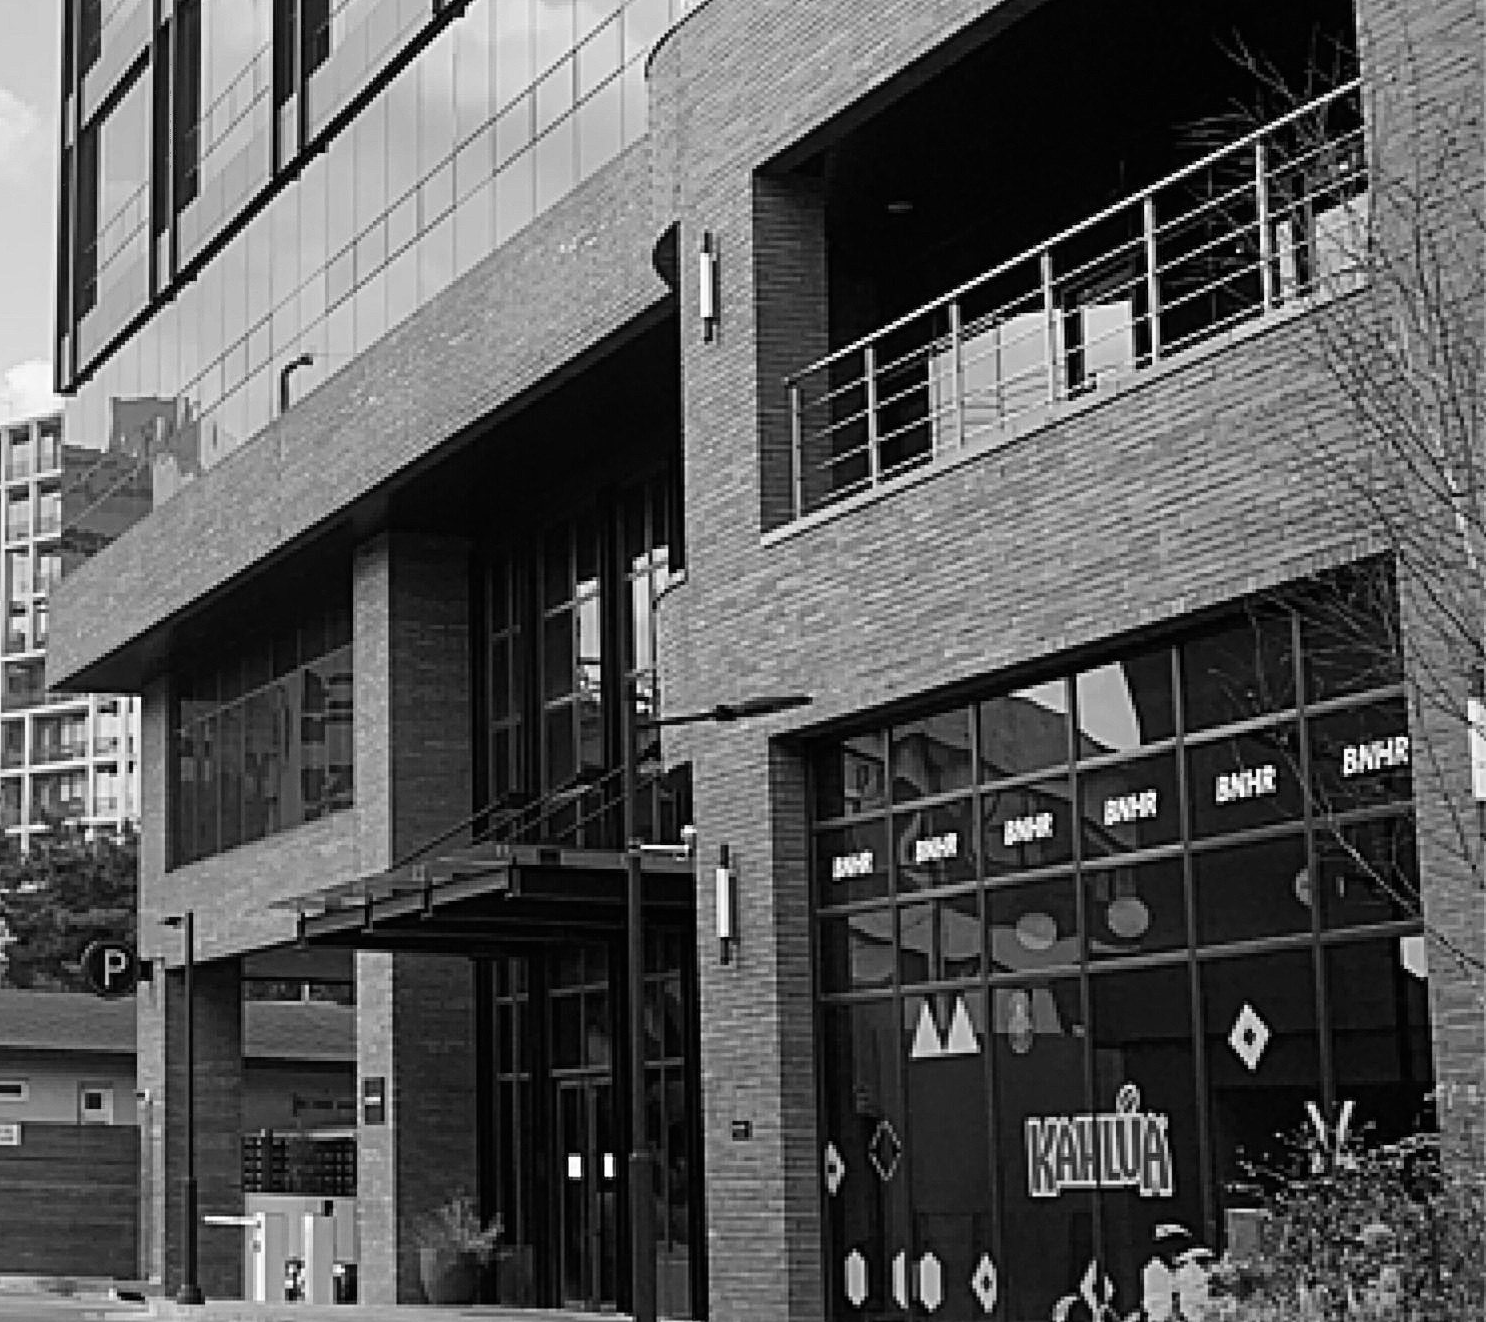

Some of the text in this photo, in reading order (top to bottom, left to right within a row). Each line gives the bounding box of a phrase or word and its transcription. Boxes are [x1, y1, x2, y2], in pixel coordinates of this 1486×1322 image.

[1343, 736, 1409, 777] BNHR
[1215, 765, 1277, 805] BNHR
[1104, 790, 1157, 825] BNHR
[1004, 813, 1053, 845] BNHR
[104, 948, 126, 989] P
